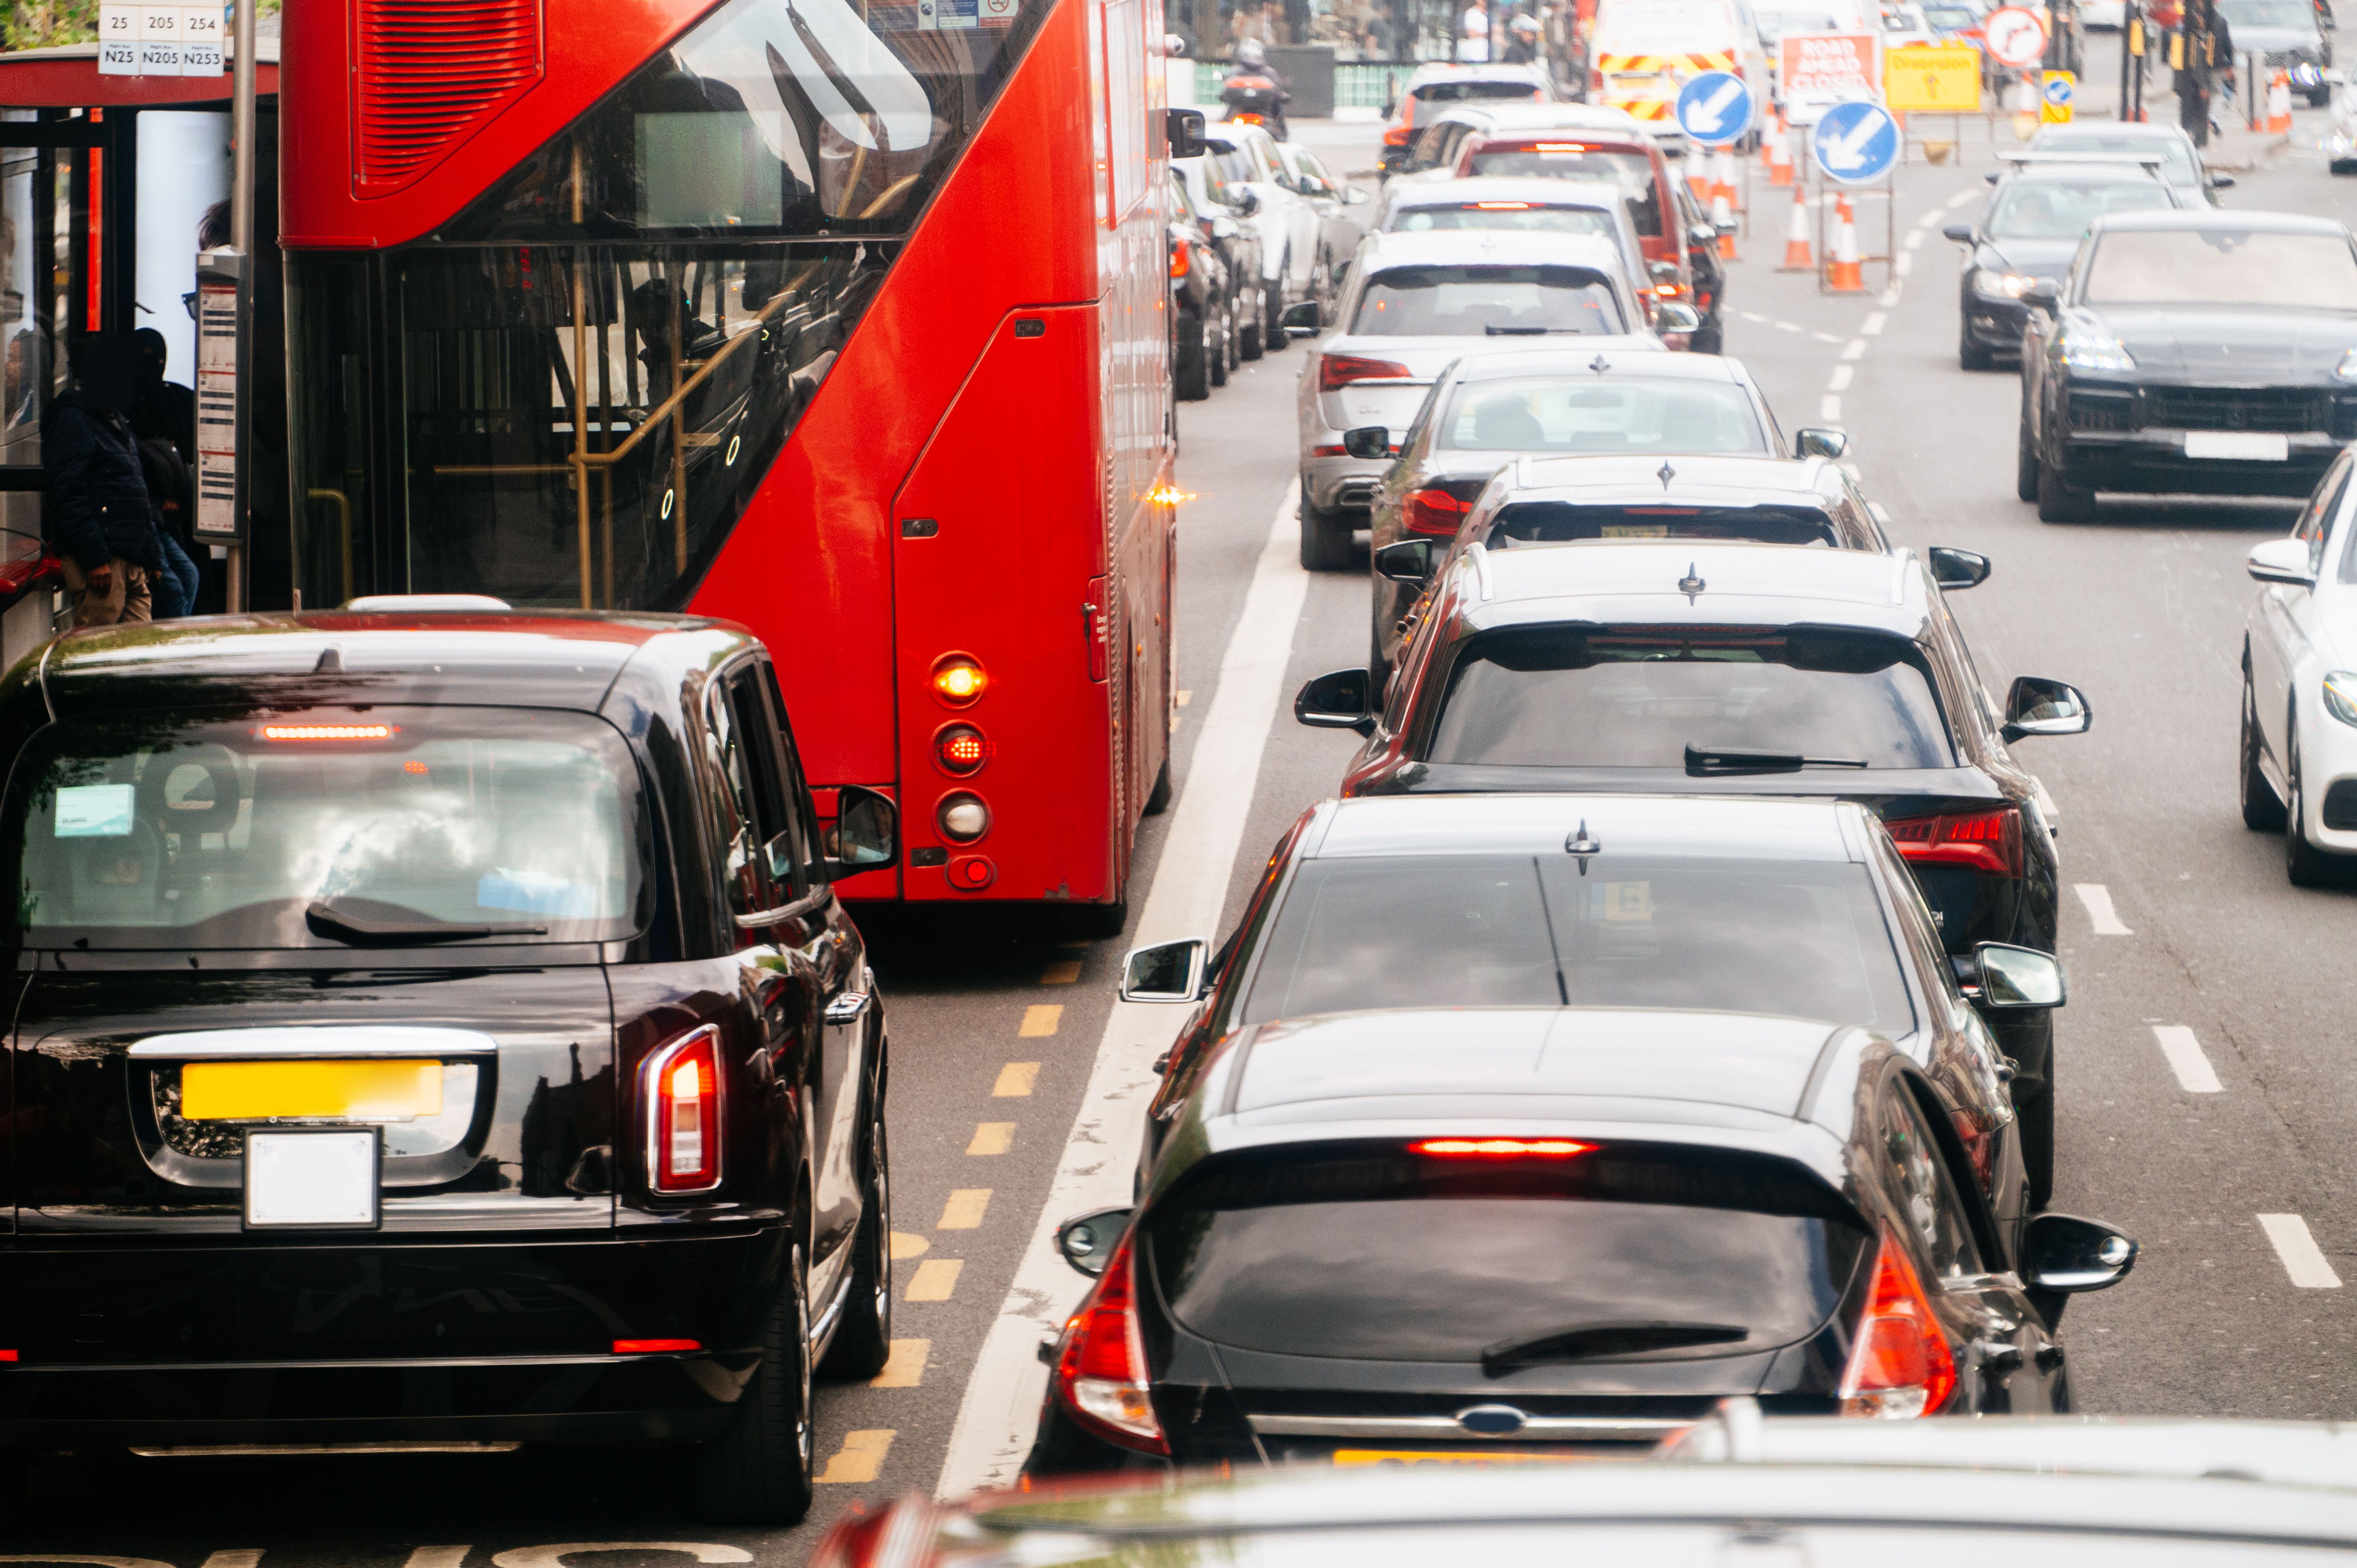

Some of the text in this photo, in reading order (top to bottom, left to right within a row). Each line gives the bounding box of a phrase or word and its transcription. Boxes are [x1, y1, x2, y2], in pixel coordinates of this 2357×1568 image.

[111, 17, 128, 29] 25
[148, 17, 174, 29] 205
[190, 18, 216, 29] 254
[1800, 38, 1856, 56] ROAD
[105, 50, 134, 63] N25
[143, 51, 179, 64] N205
[184, 53, 220, 65] N253
[1796, 55, 1861, 73] AHEAD
